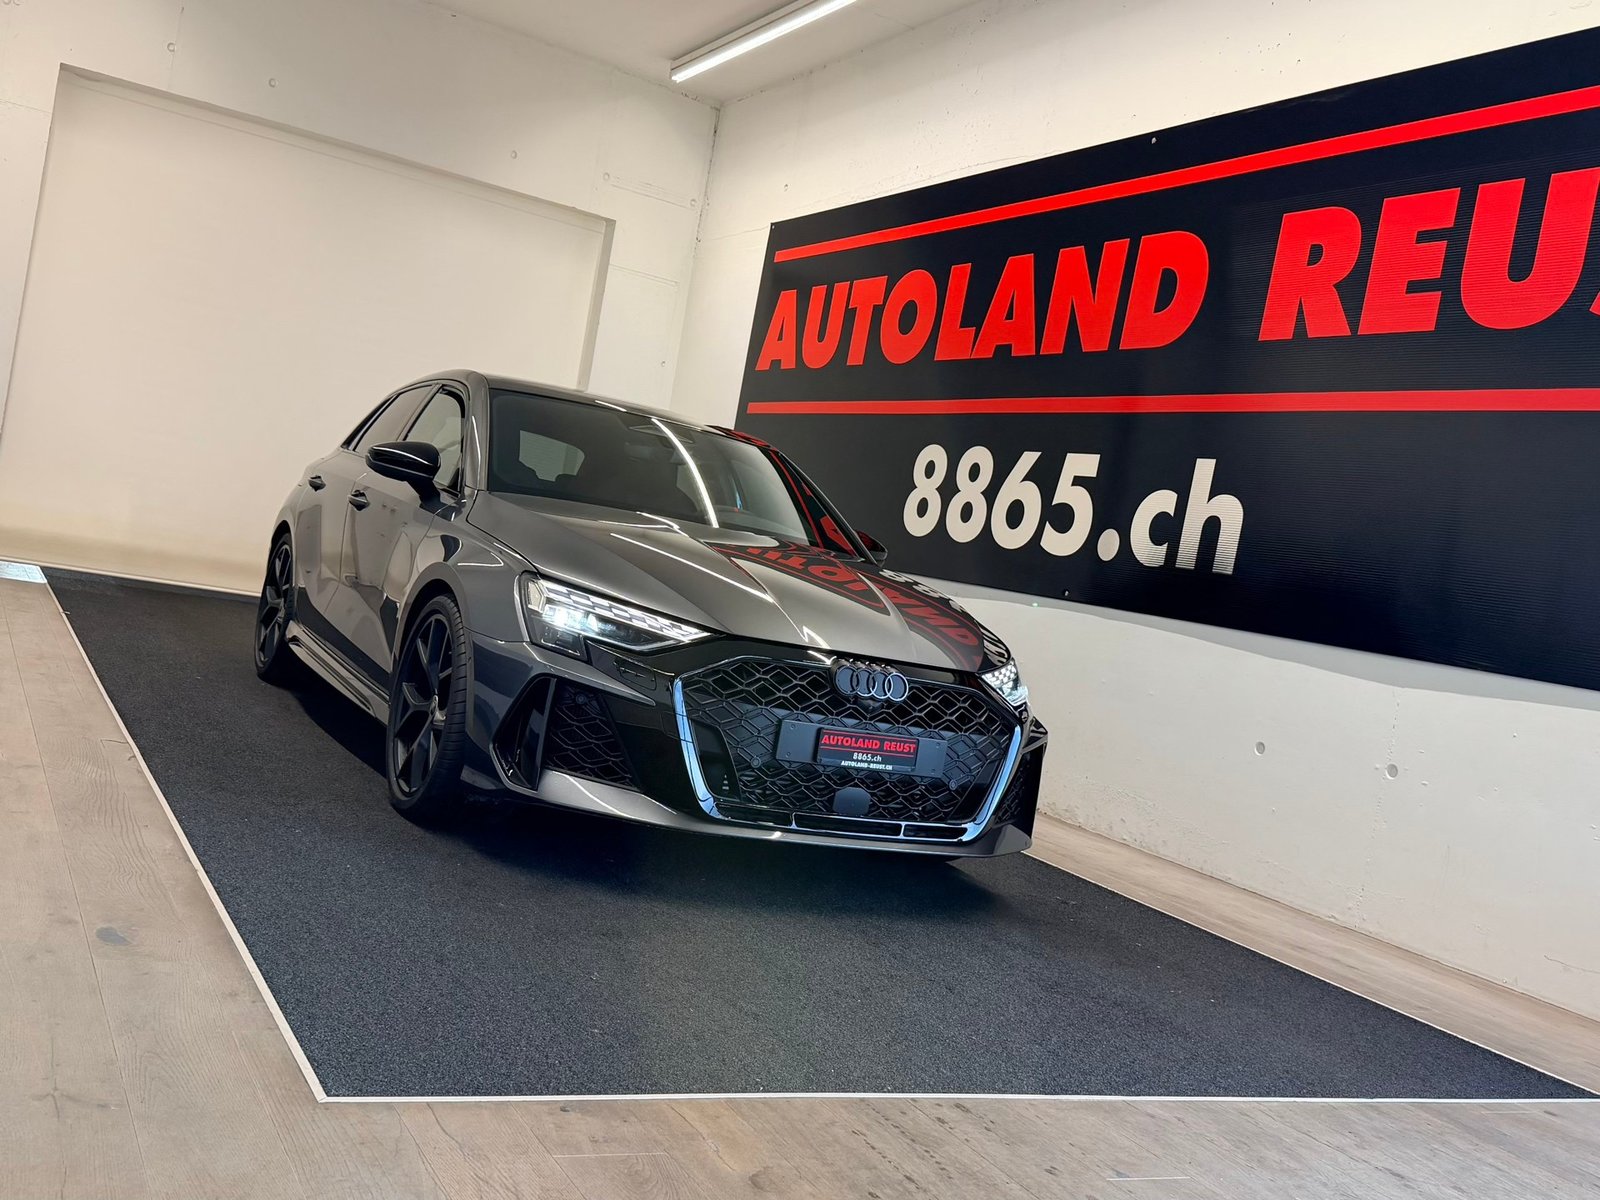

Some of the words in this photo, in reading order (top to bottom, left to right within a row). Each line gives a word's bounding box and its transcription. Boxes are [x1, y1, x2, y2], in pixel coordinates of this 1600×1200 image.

[756, 230, 1210, 372] AUTOLAND
[1258, 166, 1600, 341] REU
[903, 444, 1244, 576] 8865.ch
[821, 735, 880, 749] AUTOLAND
[883, 741, 916, 753] REUST
[841, 760, 893, 770] AUTOLAND-REUST.CH
[852, 752, 882, 762] 8865.ch
